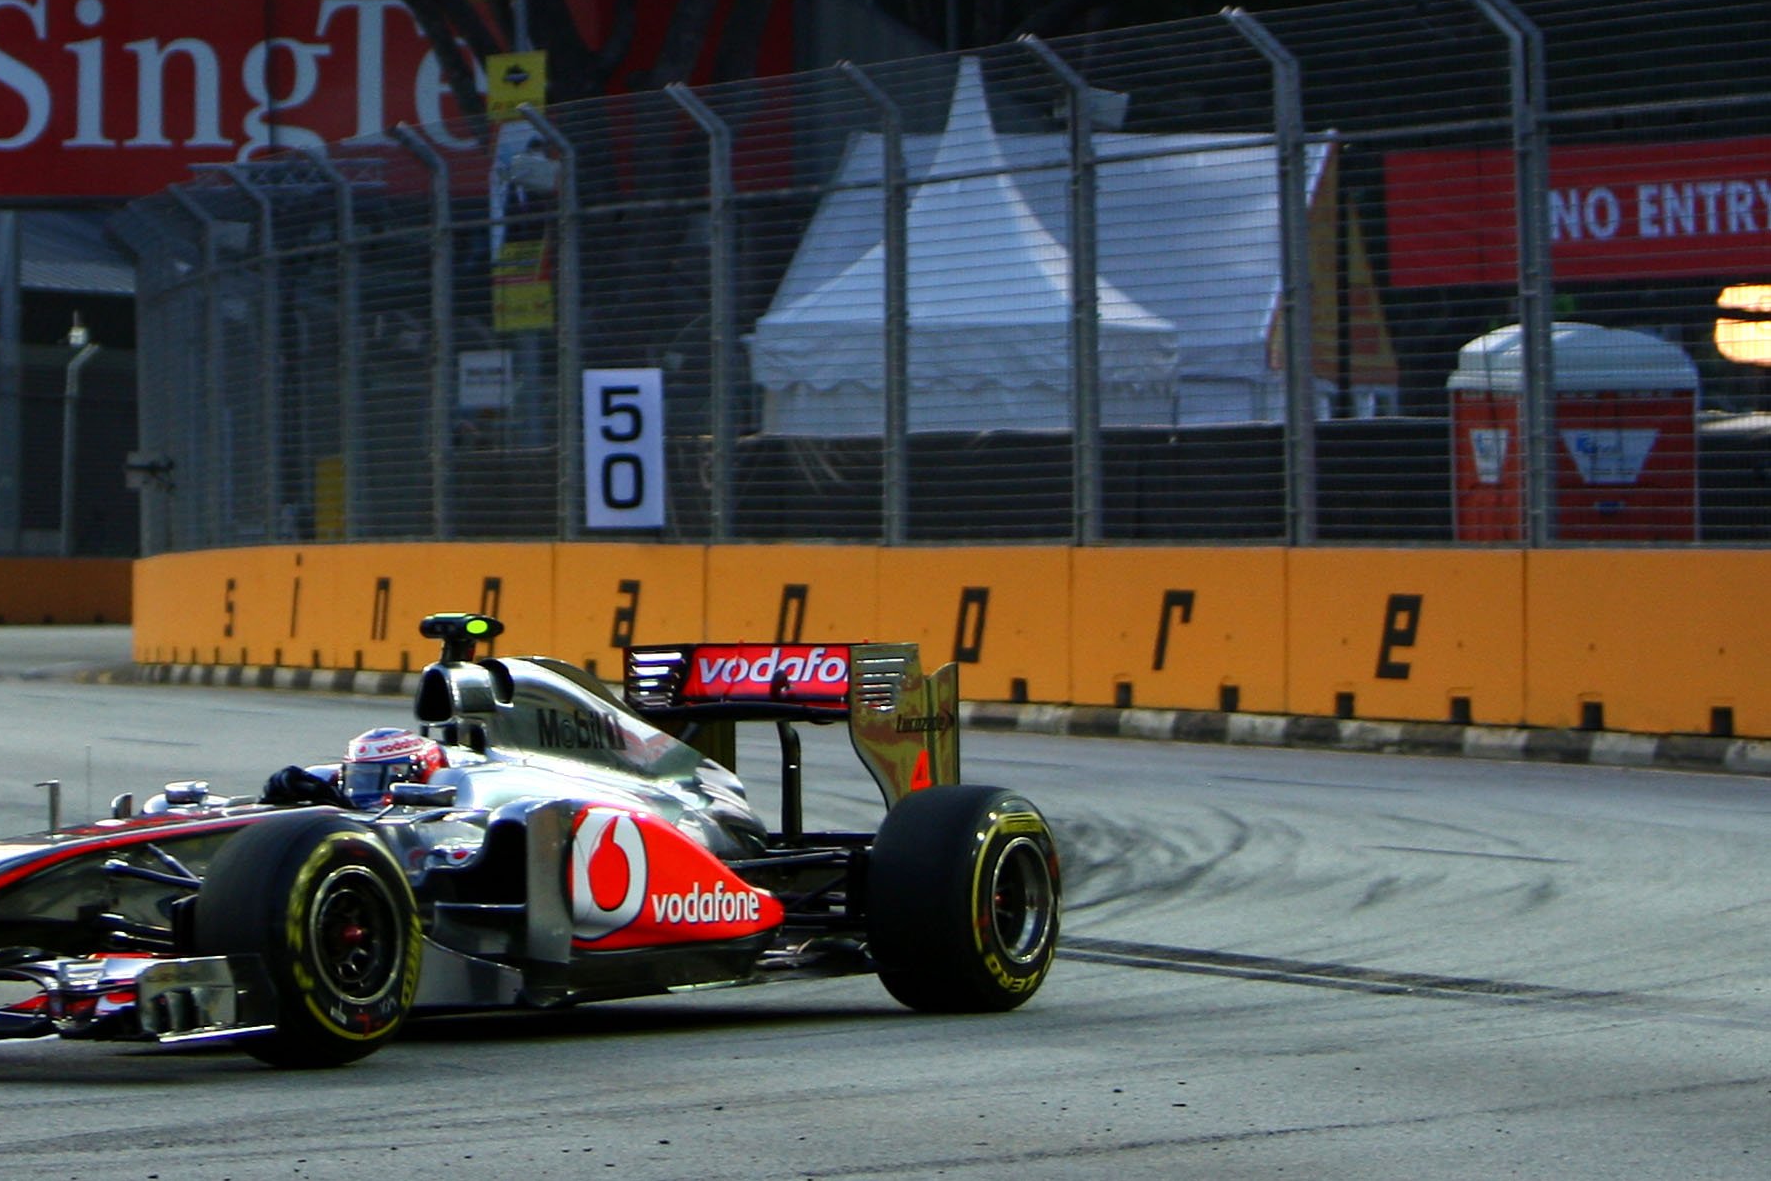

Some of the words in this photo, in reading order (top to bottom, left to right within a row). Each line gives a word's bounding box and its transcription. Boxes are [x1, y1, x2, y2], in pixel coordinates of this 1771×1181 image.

[1548, 186, 1621, 240] NO
[1637, 178, 1771, 238] ENTRY
[697, 646, 850, 685] vodafo
[537, 708, 604, 750] Mobil
[651, 879, 760, 925] vodafone
